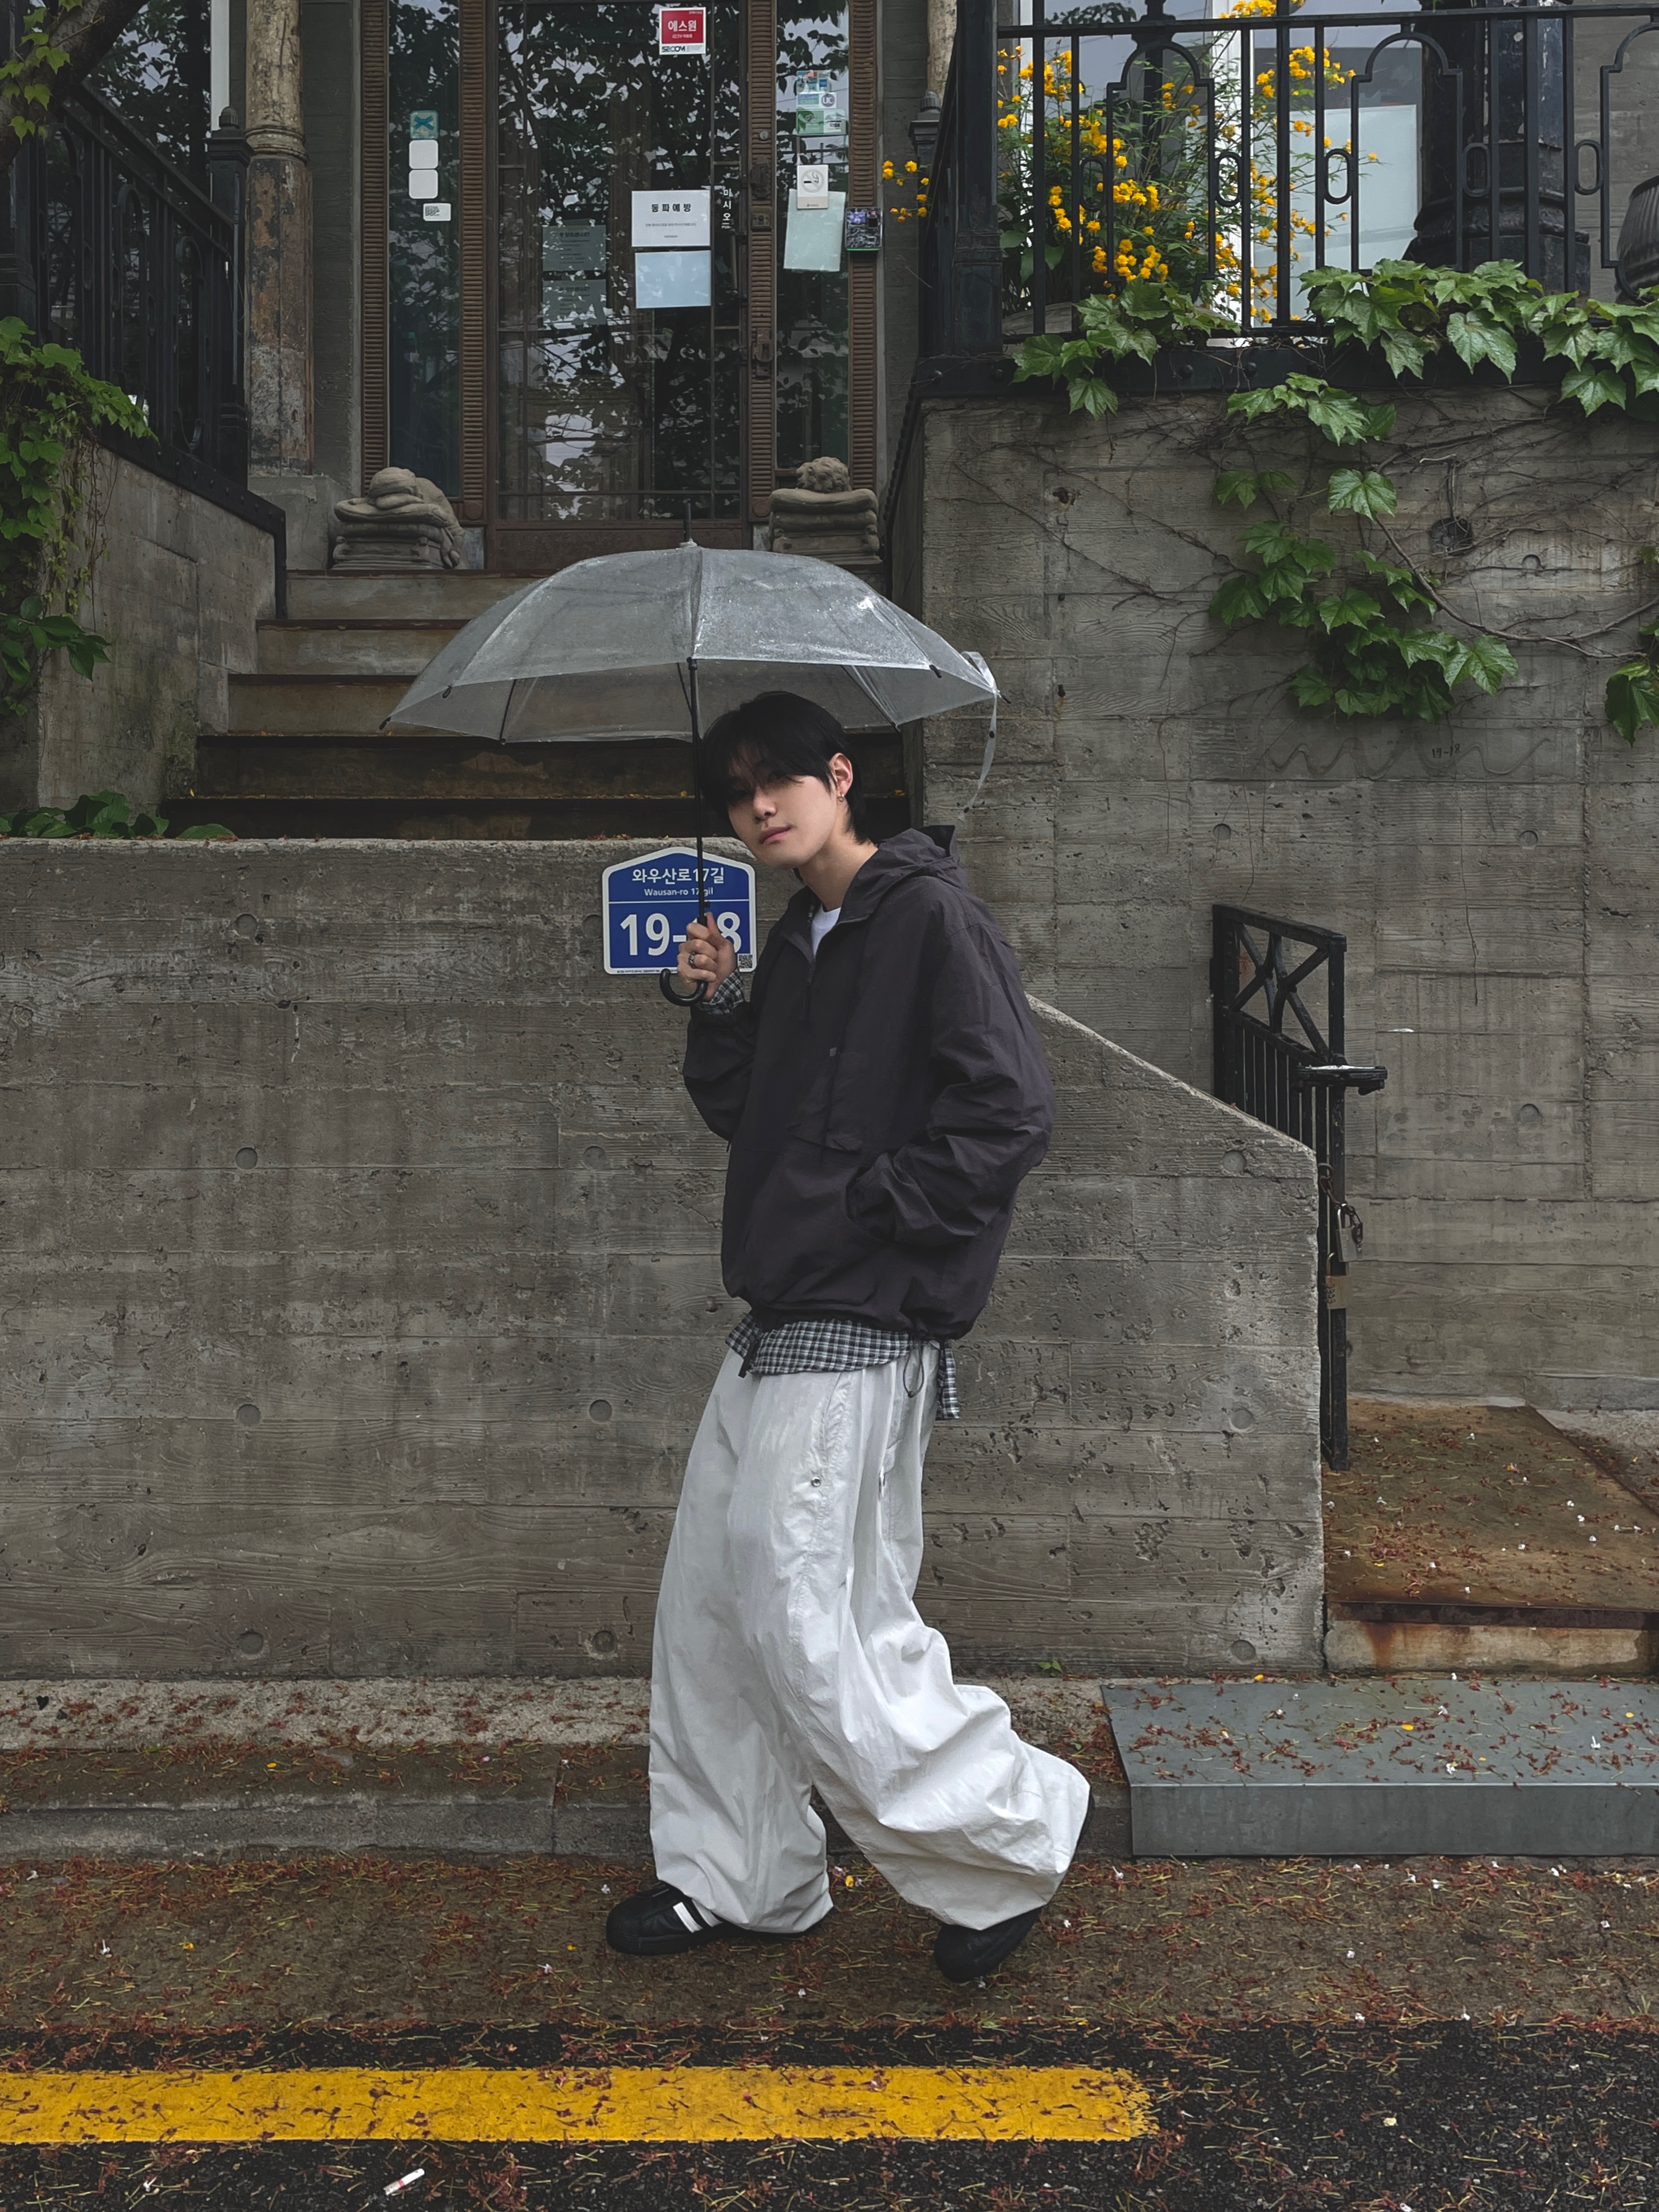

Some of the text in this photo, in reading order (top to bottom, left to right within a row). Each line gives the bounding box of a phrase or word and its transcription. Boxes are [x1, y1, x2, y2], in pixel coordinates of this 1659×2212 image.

[668, 20, 697, 32] 에스원
[651, 203, 692, 213] 동파예방
[722, 188, 732, 221] 미시오
[632, 866, 724, 884] 와우산로17길
[620, 912, 741, 956] 19-8
